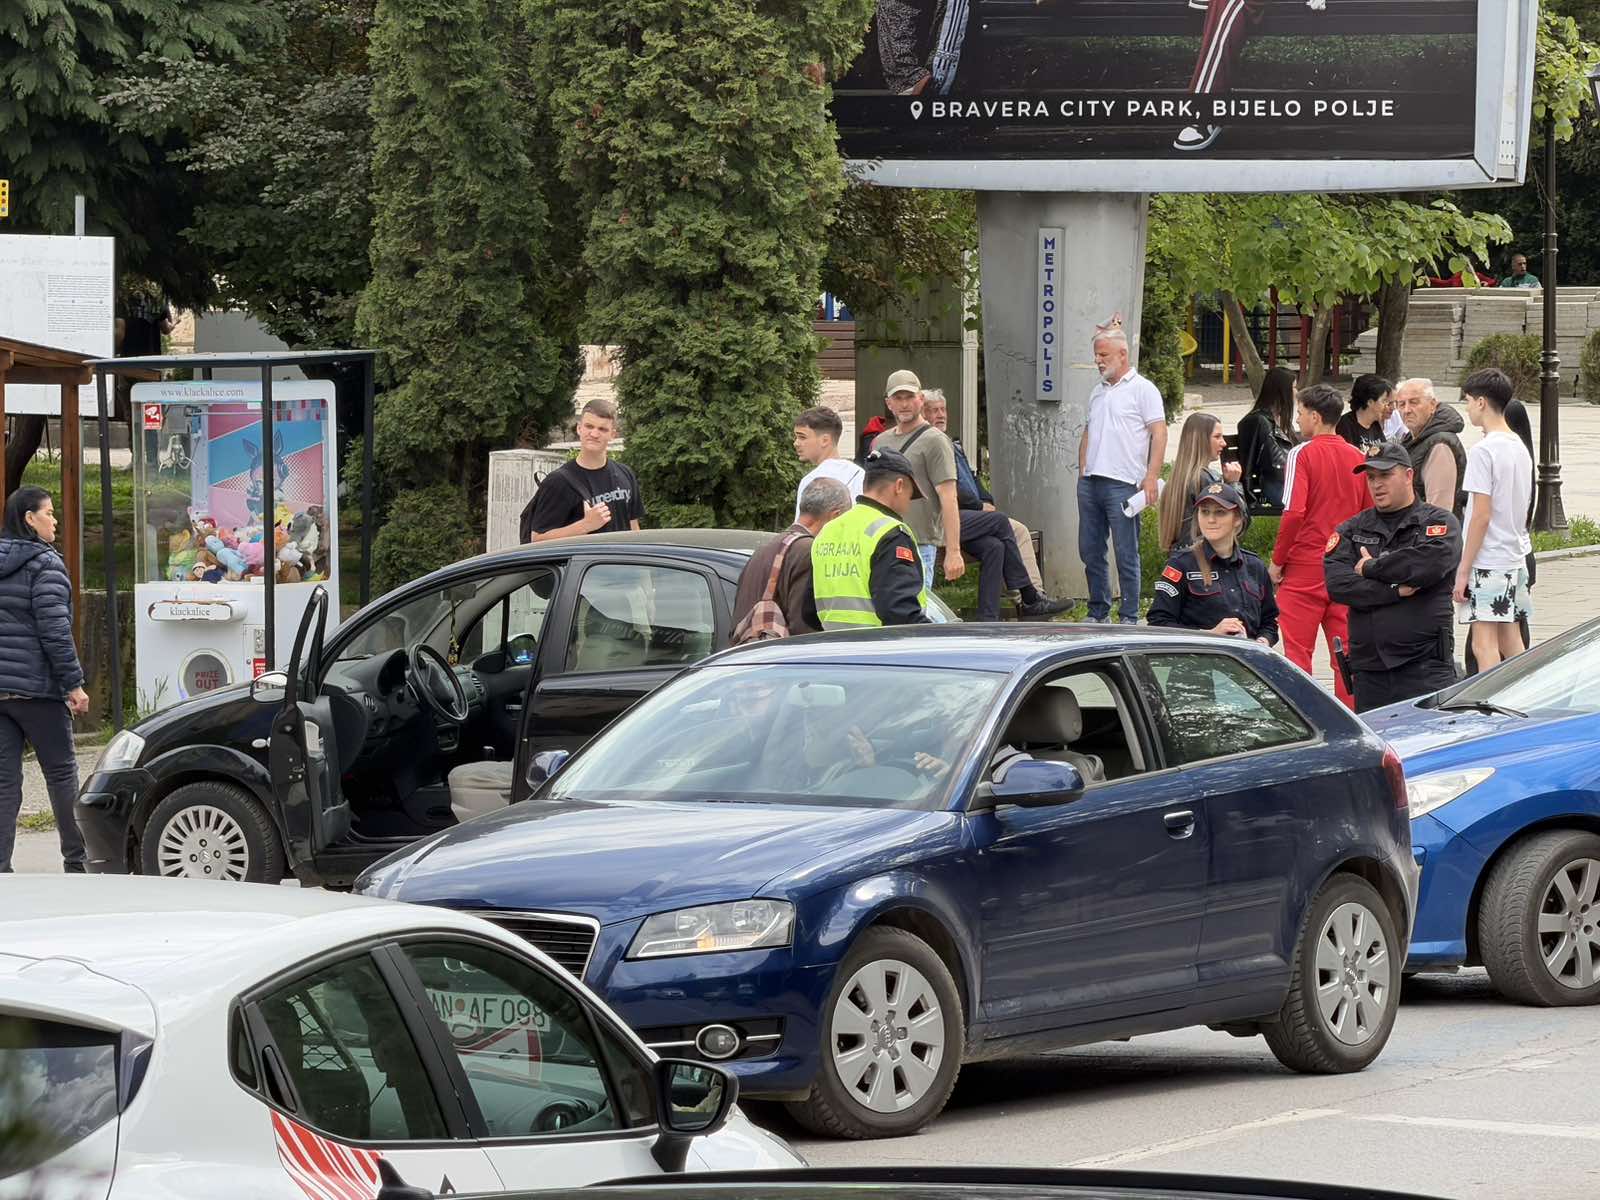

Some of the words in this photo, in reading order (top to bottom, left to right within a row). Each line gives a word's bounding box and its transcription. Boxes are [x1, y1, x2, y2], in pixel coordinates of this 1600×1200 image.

[932, 100, 1050, 118] BRAVERA
[1060, 100, 1116, 117] CITY
[1126, 100, 1201, 119] PARK,
[1213, 100, 1301, 117] BIJELO
[1314, 100, 1395, 117] POLJE
[1042, 237, 1056, 393] METROPOLIS
[591, 486, 631, 505] uperdry
